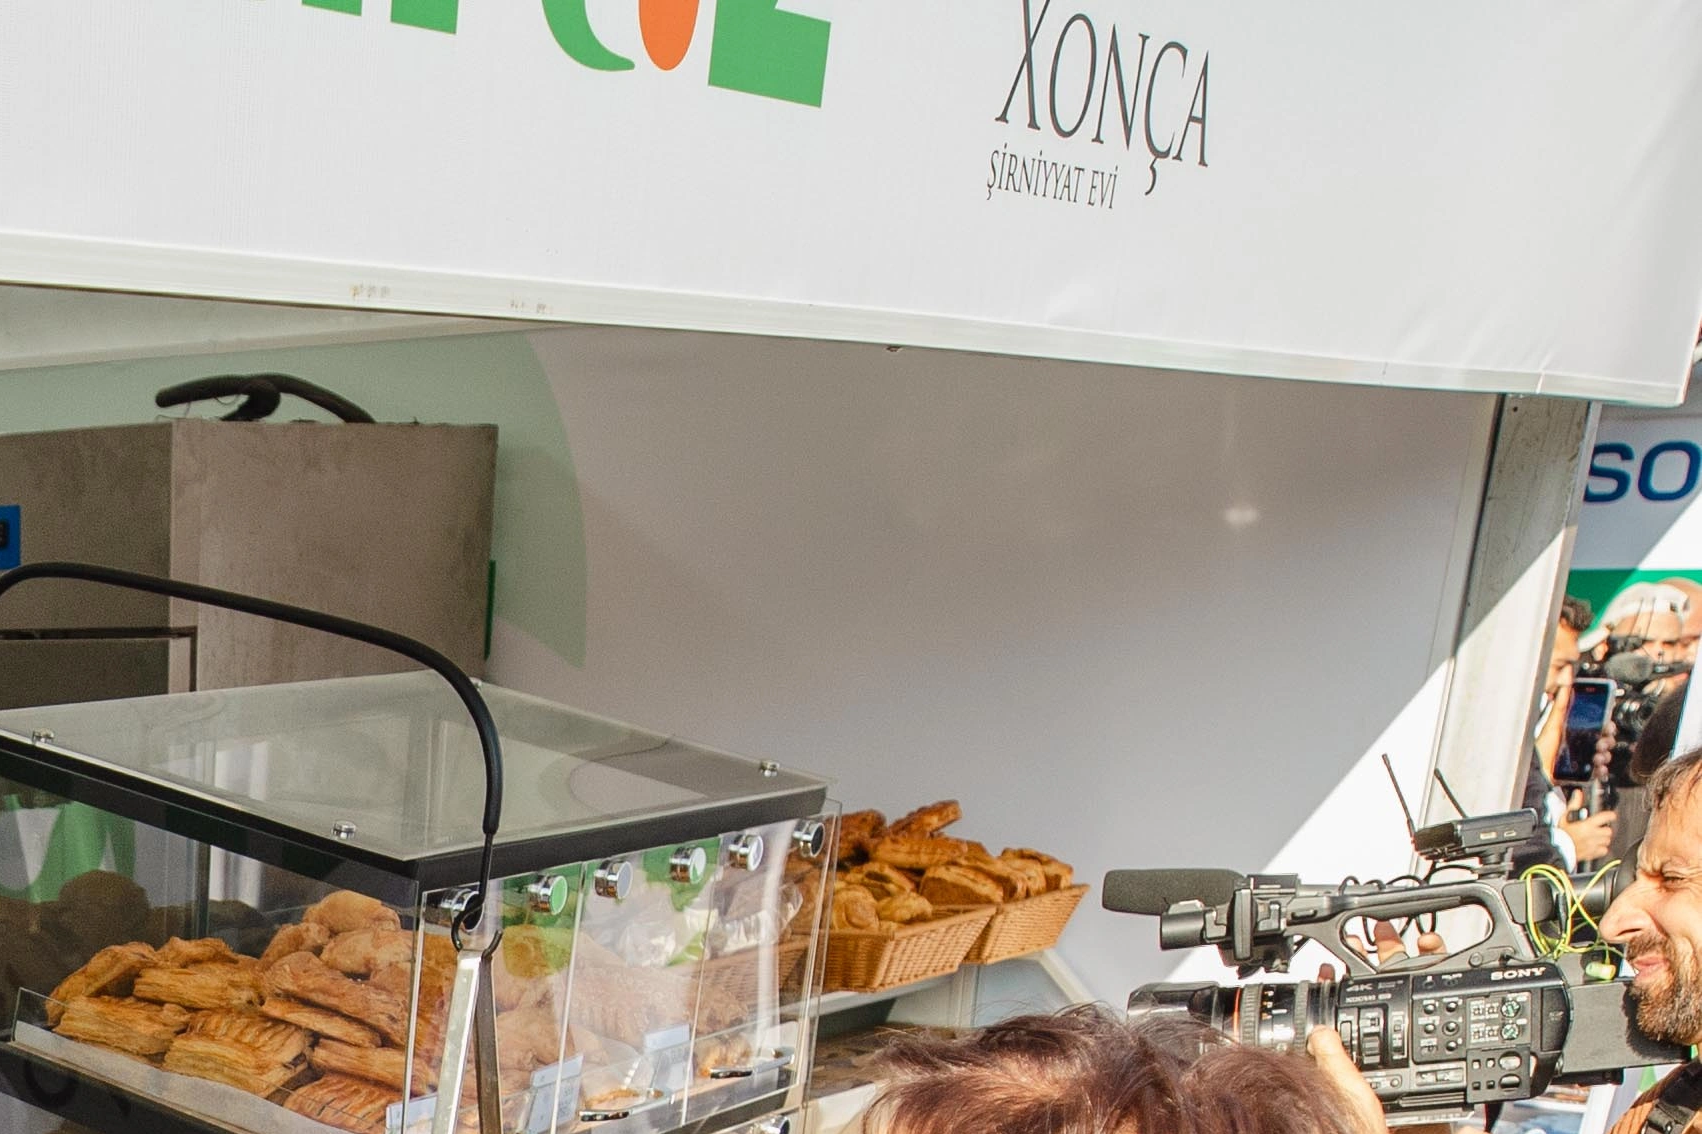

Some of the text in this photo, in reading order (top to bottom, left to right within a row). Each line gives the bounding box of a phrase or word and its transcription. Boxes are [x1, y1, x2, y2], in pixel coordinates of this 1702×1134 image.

[994, 0, 1209, 196] XONÇA
[986, 142, 1119, 210] ŞİRNİYYAT EVİ
[1490, 966, 1546, 981] SONY
